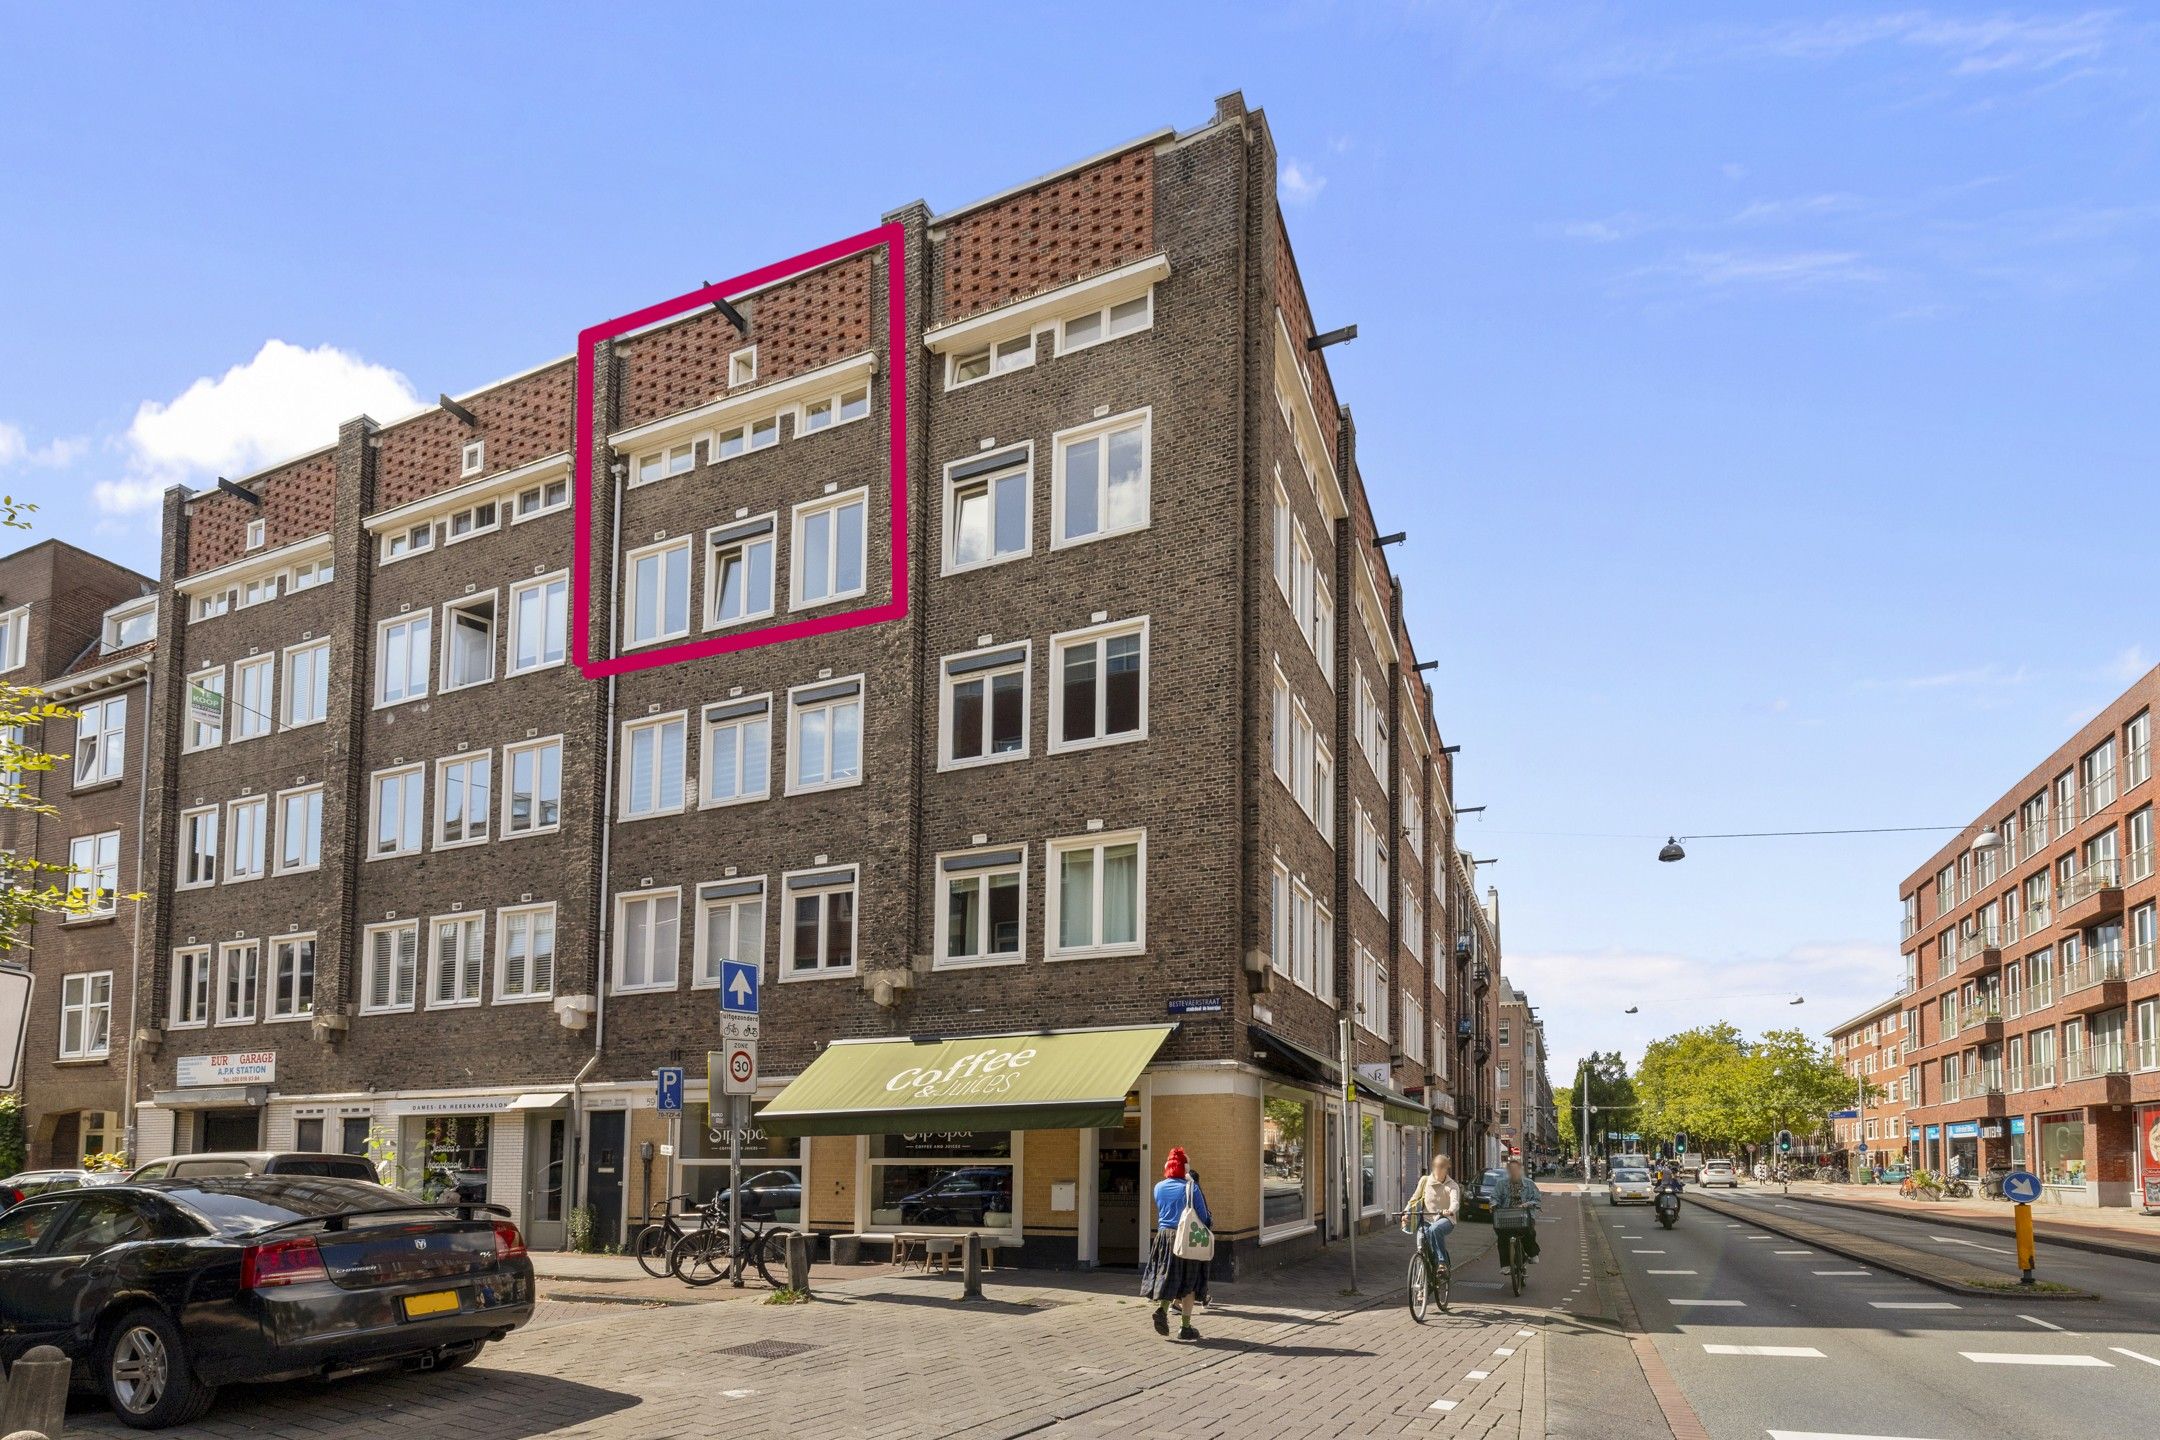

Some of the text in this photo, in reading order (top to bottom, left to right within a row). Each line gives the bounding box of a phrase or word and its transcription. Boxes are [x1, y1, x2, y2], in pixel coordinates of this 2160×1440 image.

[193, 695, 219, 707] KOOP
[1168, 997, 1220, 1008] BESTEVAERSTRAAT
[722, 1013, 759, 1022] uitgezonderd
[240, 1052, 274, 1065] GARAGE
[236, 1065, 266, 1075] STATION
[734, 1060, 749, 1073] 30
[886, 1049, 1037, 1092] Coffee
[663, 1071, 677, 1093] P
[914, 1085, 935, 1098] &
[646, 1098, 656, 1107] 59
[336, 1265, 377, 1274] CHARGER
